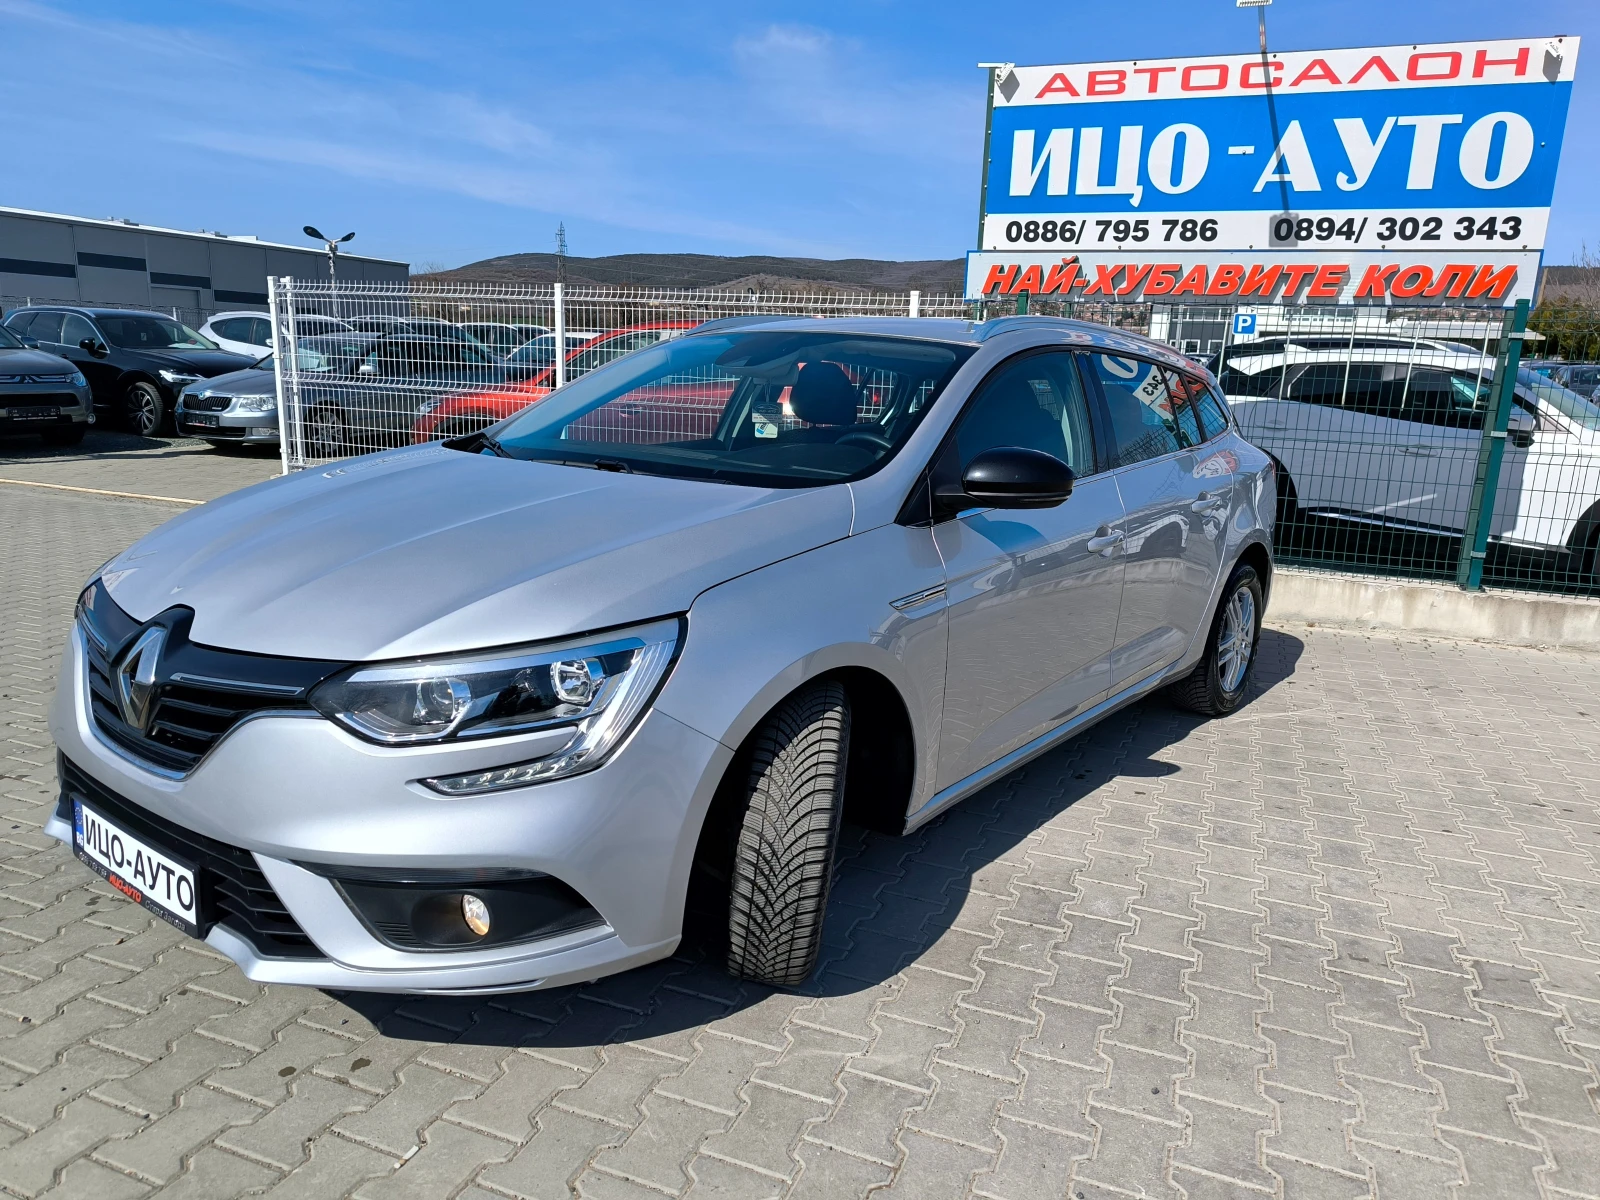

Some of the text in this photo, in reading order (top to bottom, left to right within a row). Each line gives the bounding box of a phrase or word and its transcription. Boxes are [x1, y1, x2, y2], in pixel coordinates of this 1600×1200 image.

[1037, 47, 1531, 99] АВТОСАЛОН
[1005, 218, 1218, 245] 0886/ 795 786
[1273, 216, 1522, 244] 0894/ 302 343
[982, 256, 1518, 299] НАЙ-ХУБАВИТЕ КОЛИ
[1237, 315, 1252, 332] P
[85, 814, 194, 912] ИЦО-АУТО
